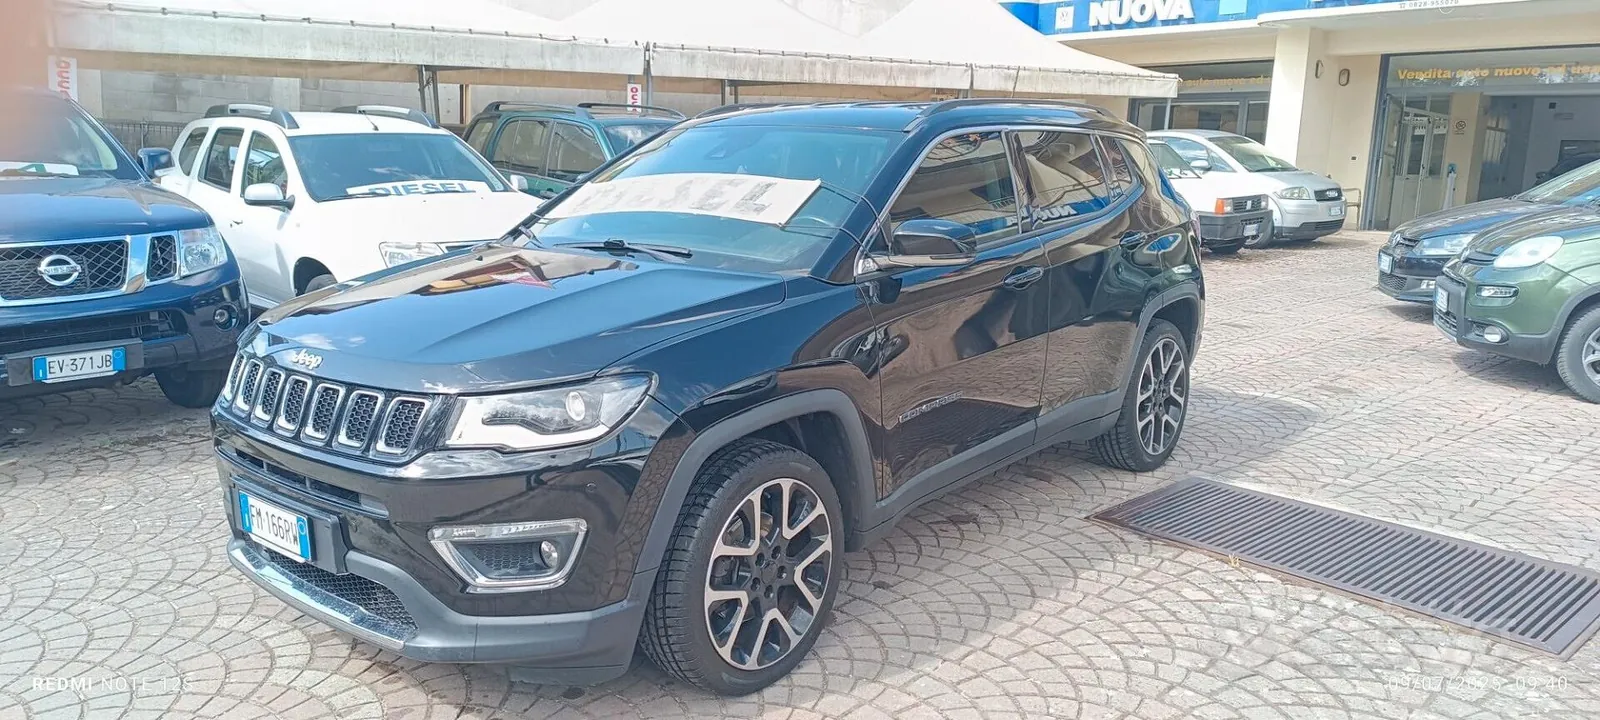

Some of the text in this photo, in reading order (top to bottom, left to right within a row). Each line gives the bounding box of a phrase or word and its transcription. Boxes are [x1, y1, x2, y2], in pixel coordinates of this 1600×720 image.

[1088, 0, 1194, 27] NUOVA
[1398, 69, 1451, 80] Vendita
[367, 182, 477, 196] DIESEL
[292, 348, 324, 370] Jeep
